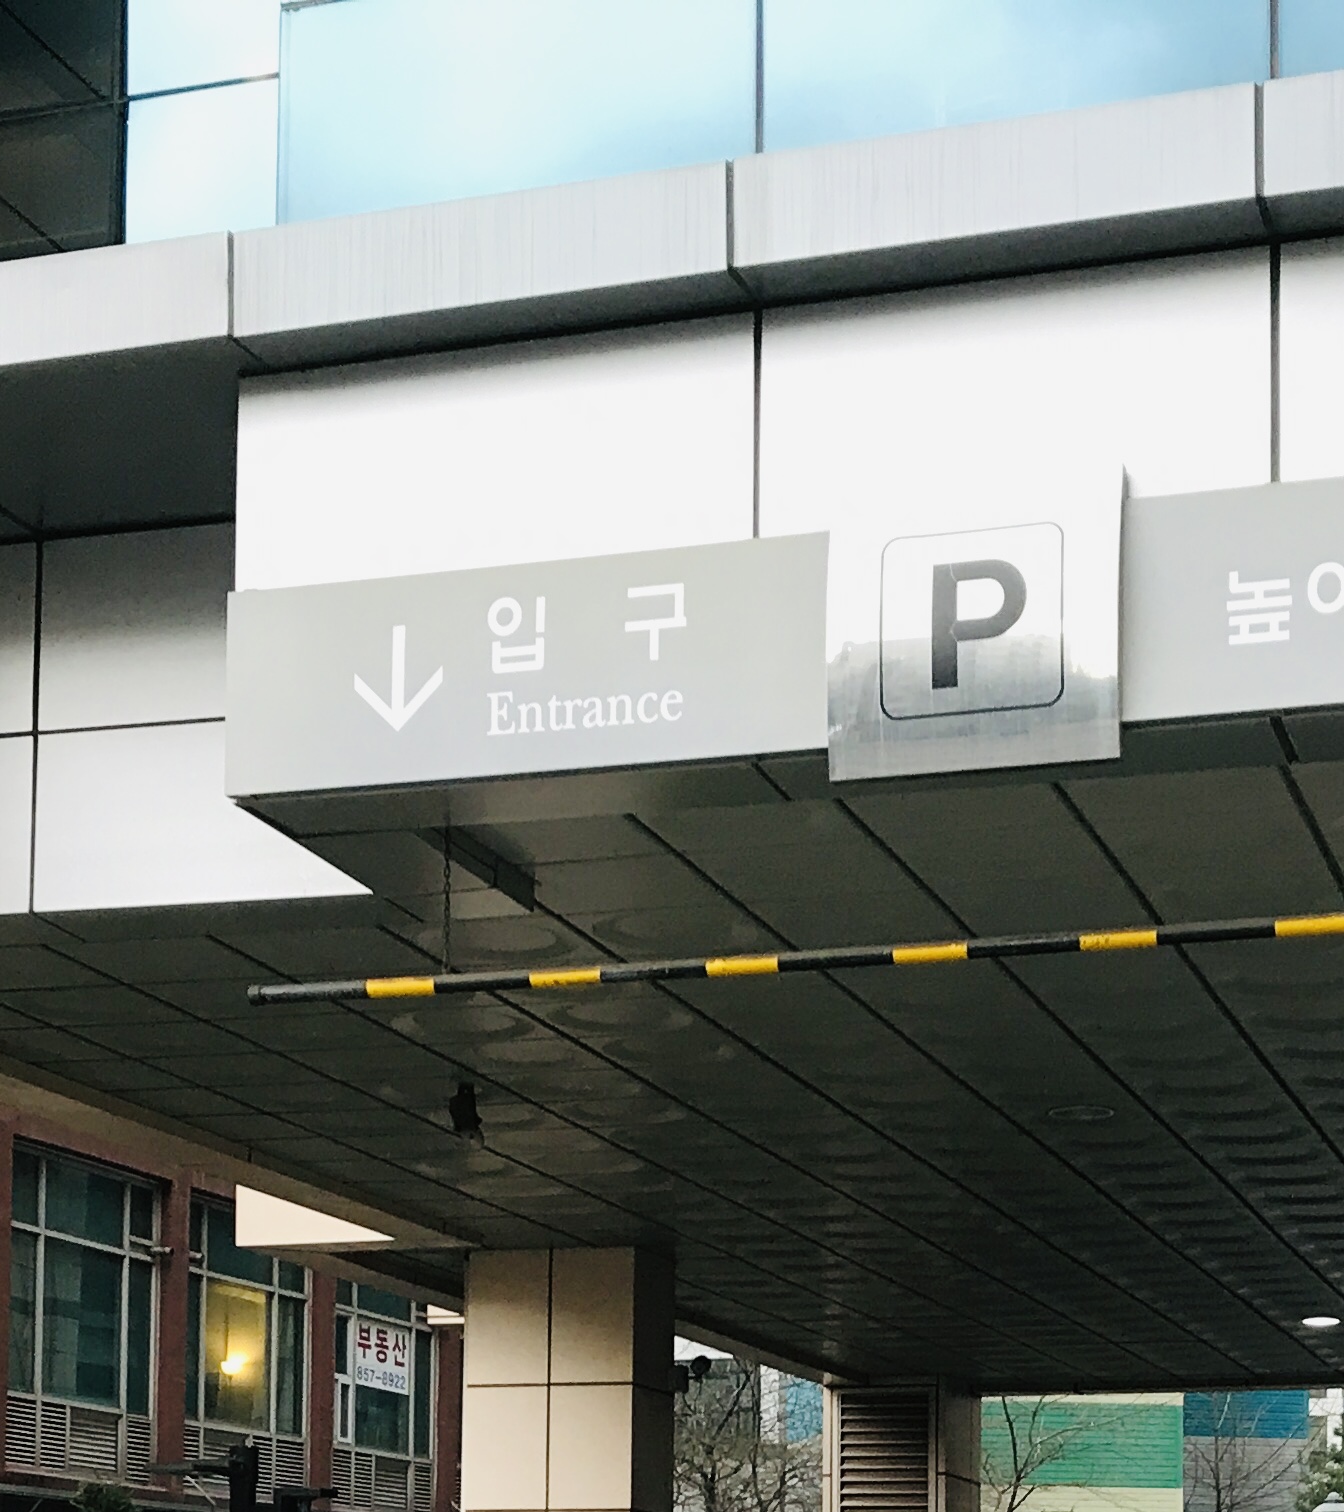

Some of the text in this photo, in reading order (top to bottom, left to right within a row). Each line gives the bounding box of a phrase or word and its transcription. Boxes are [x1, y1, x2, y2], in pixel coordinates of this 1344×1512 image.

[931, 559, 1027, 690] P
[486, 689, 684, 736] Entrance
[357, 1323, 407, 1368] 부동산
